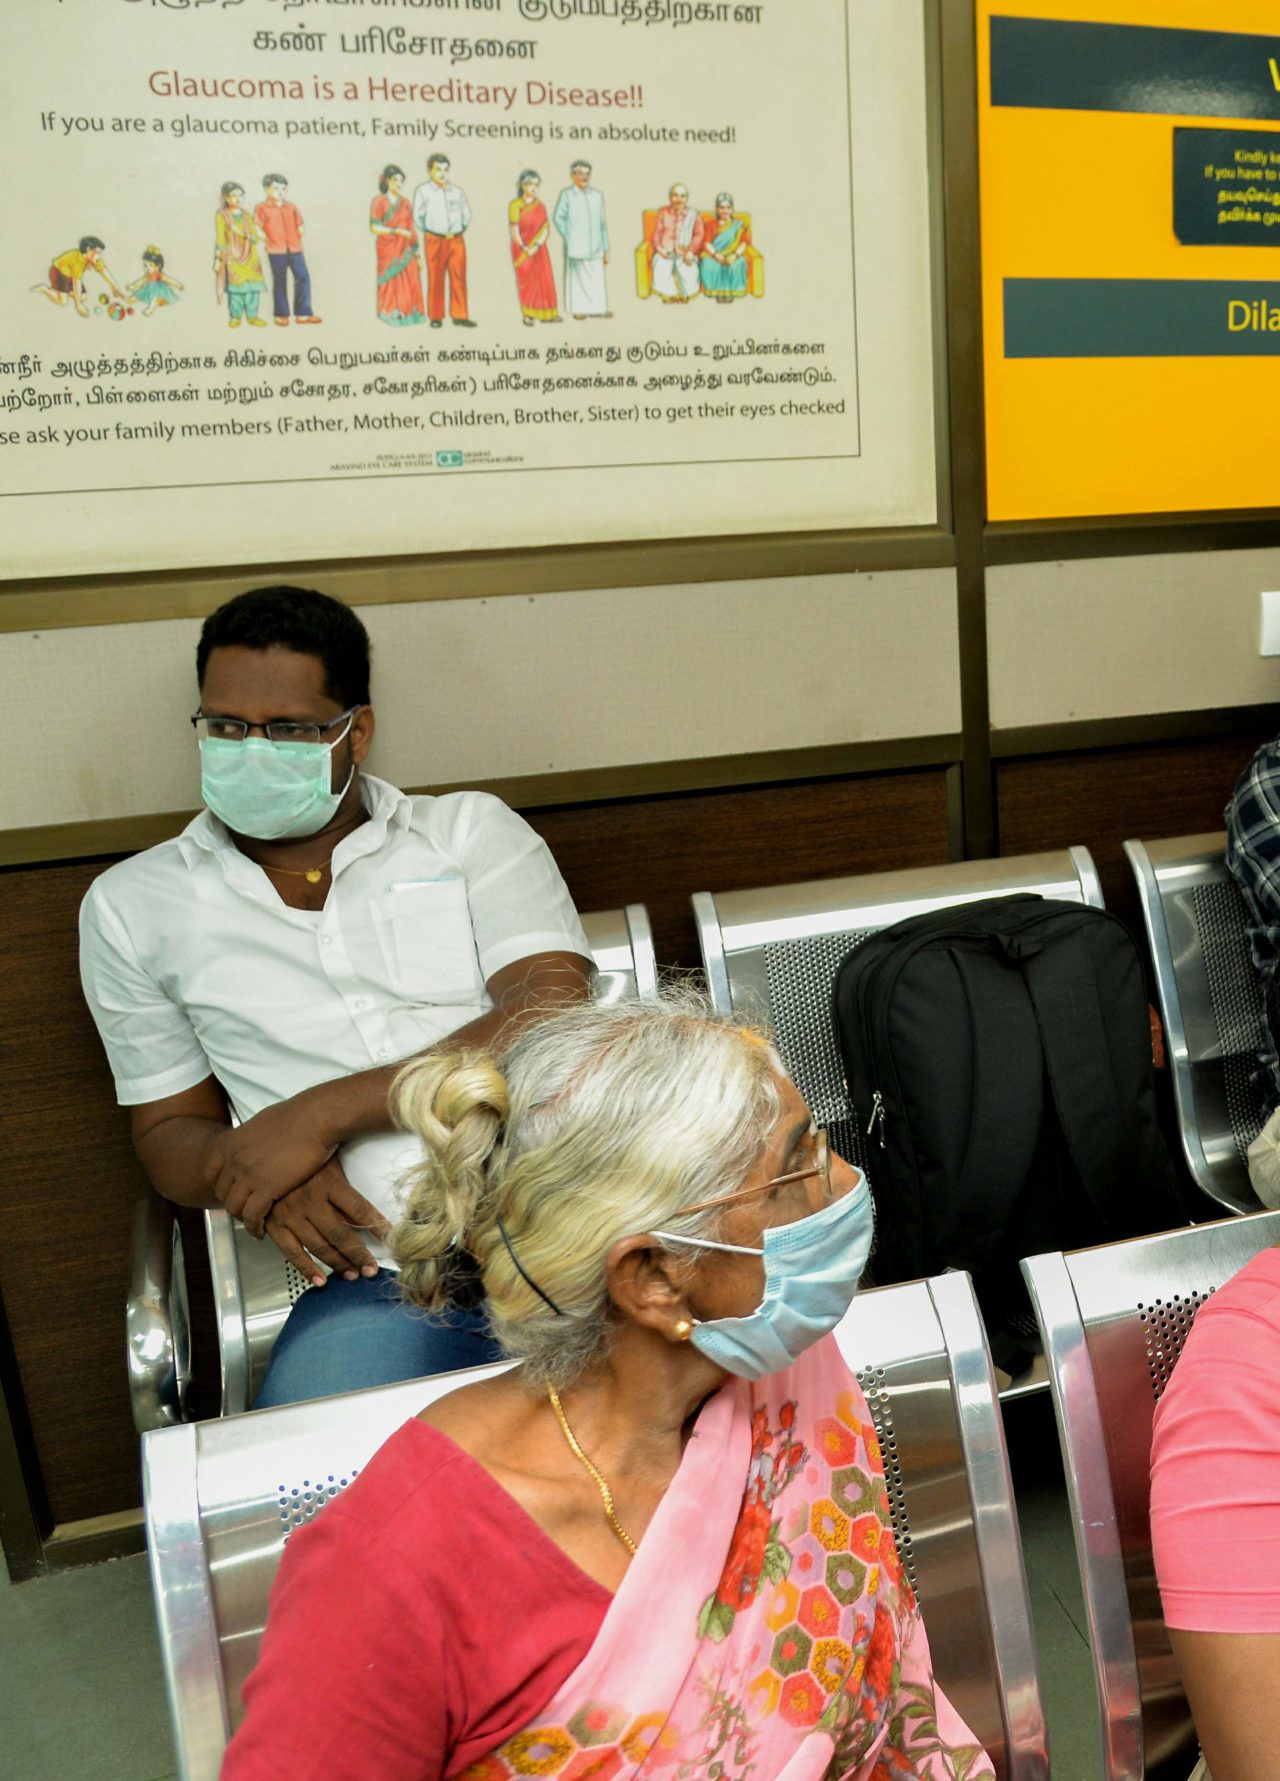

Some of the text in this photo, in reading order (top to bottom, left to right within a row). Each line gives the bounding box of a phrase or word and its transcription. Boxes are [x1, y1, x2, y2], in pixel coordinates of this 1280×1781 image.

[253, 24, 537, 64] கண் பரிசோதனை
[149, 71, 643, 109] Glaucoma is a Hereditary Disease!!
[41, 112, 736, 143] If you are a glaucoma patient, Family Screening is an absolute need!
[1204, 164, 1214, 178] If
[1215, 168, 1236, 181] you
[1237, 166, 1263, 180] have
[1265, 168, 1277, 181] to
[1234, 149, 1268, 166] Kindly
[51, 352, 216, 379] அழுத்தத்திற்காக
[223, 349, 300, 368] சிகிச்சை
[307, 346, 430, 371] பெறுபவர்கள்
[437, 344, 540, 366] கண்டிப்பாக
[546, 343, 621, 364] தங்களது
[627, 341, 688, 362] குடும்ப
[86, 384, 200, 404] பிள்ளைகள்
[208, 382, 273, 404] மற்றும்
[483, 372, 638, 395] பரிசோதனைக்காக
[643, 369, 723, 391] அழைத்து
[27, 426, 59, 443] ask
[66, 426, 109, 447] your
[116, 421, 175, 442] family
[181, 418, 272, 437] members
[277, 416, 348, 435] (Father,
[354, 412, 425, 431] Mother,
[430, 410, 510, 428] Children,
[515, 407, 583, 425] Brother,
[588, 405, 639, 422] Sister)
[645, 405, 662, 420] to
[666, 407, 694, 425] get
[698, 402, 736, 418] their
[740, 402, 776, 420] eyes
[780, 398, 846, 415] checked
